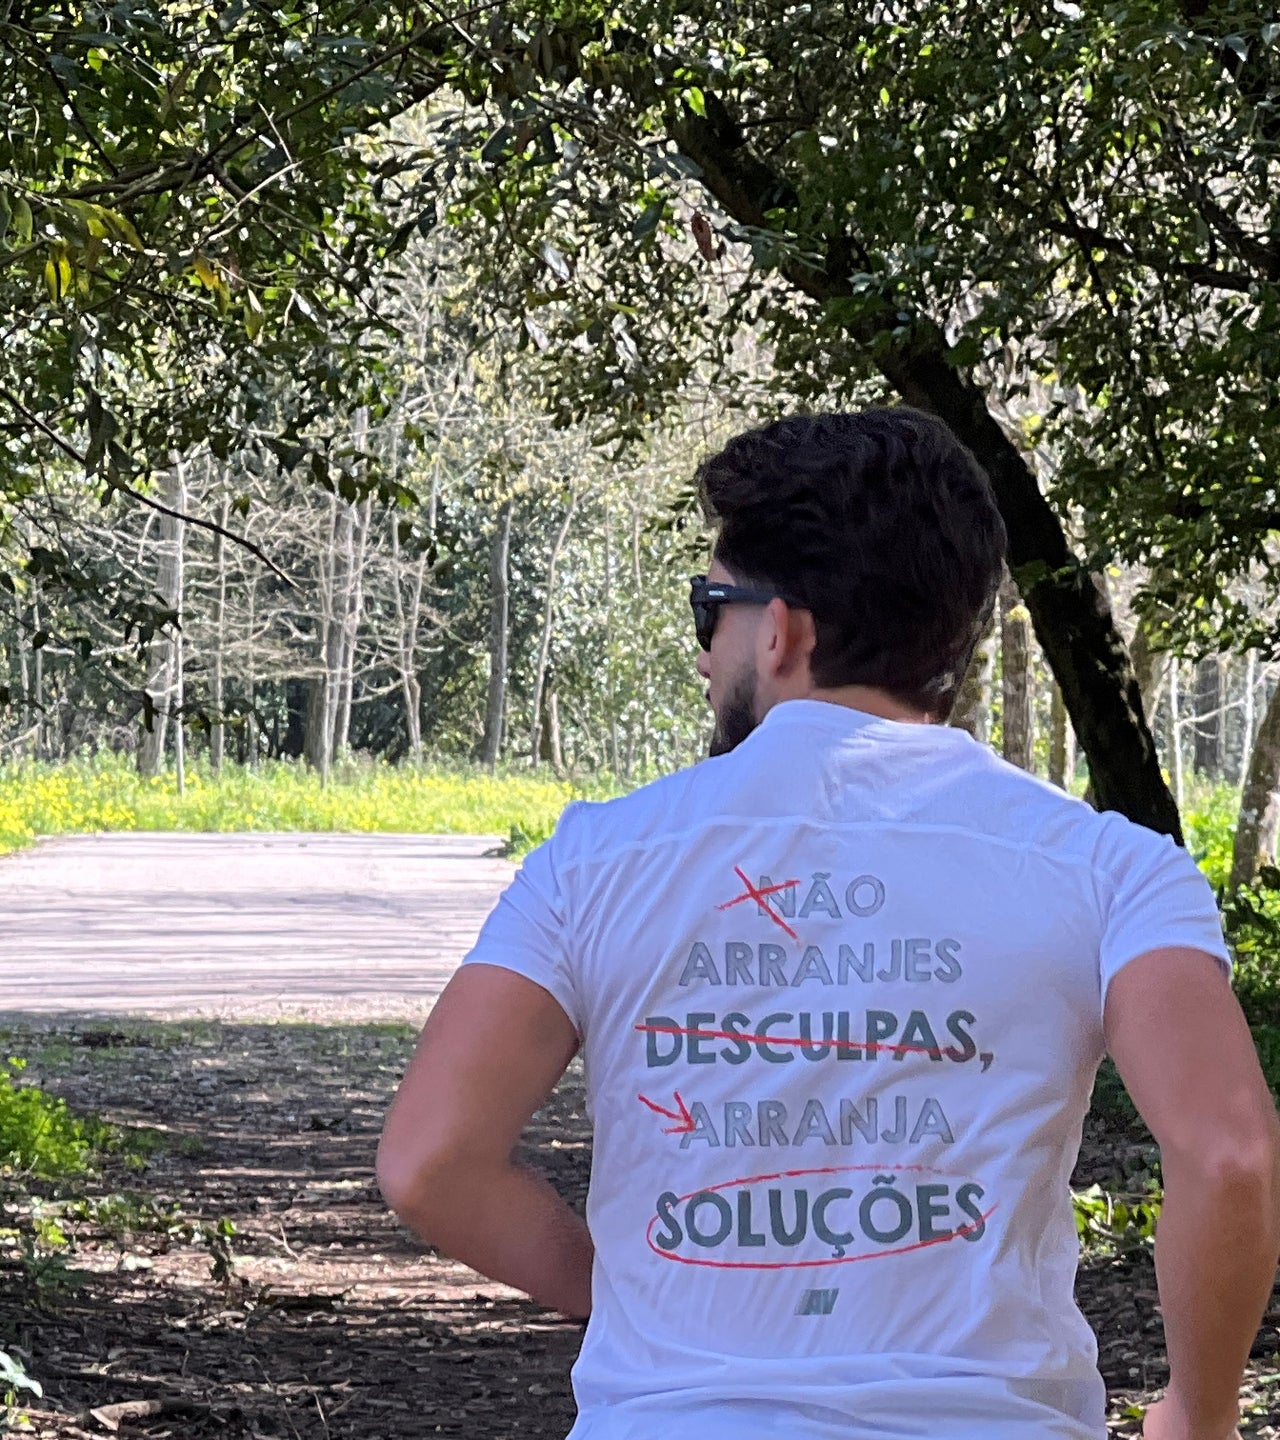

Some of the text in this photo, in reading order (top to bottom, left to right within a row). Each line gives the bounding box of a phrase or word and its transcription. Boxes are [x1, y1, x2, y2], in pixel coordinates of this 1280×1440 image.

[757, 872, 886, 919] NÃO
[679, 938, 963, 988] ARRANJES
[645, 1009, 995, 1073] DESCULPAS,
[679, 1095, 955, 1149] ARRANJA
[654, 1173, 986, 1259] SOLUÇÕES
